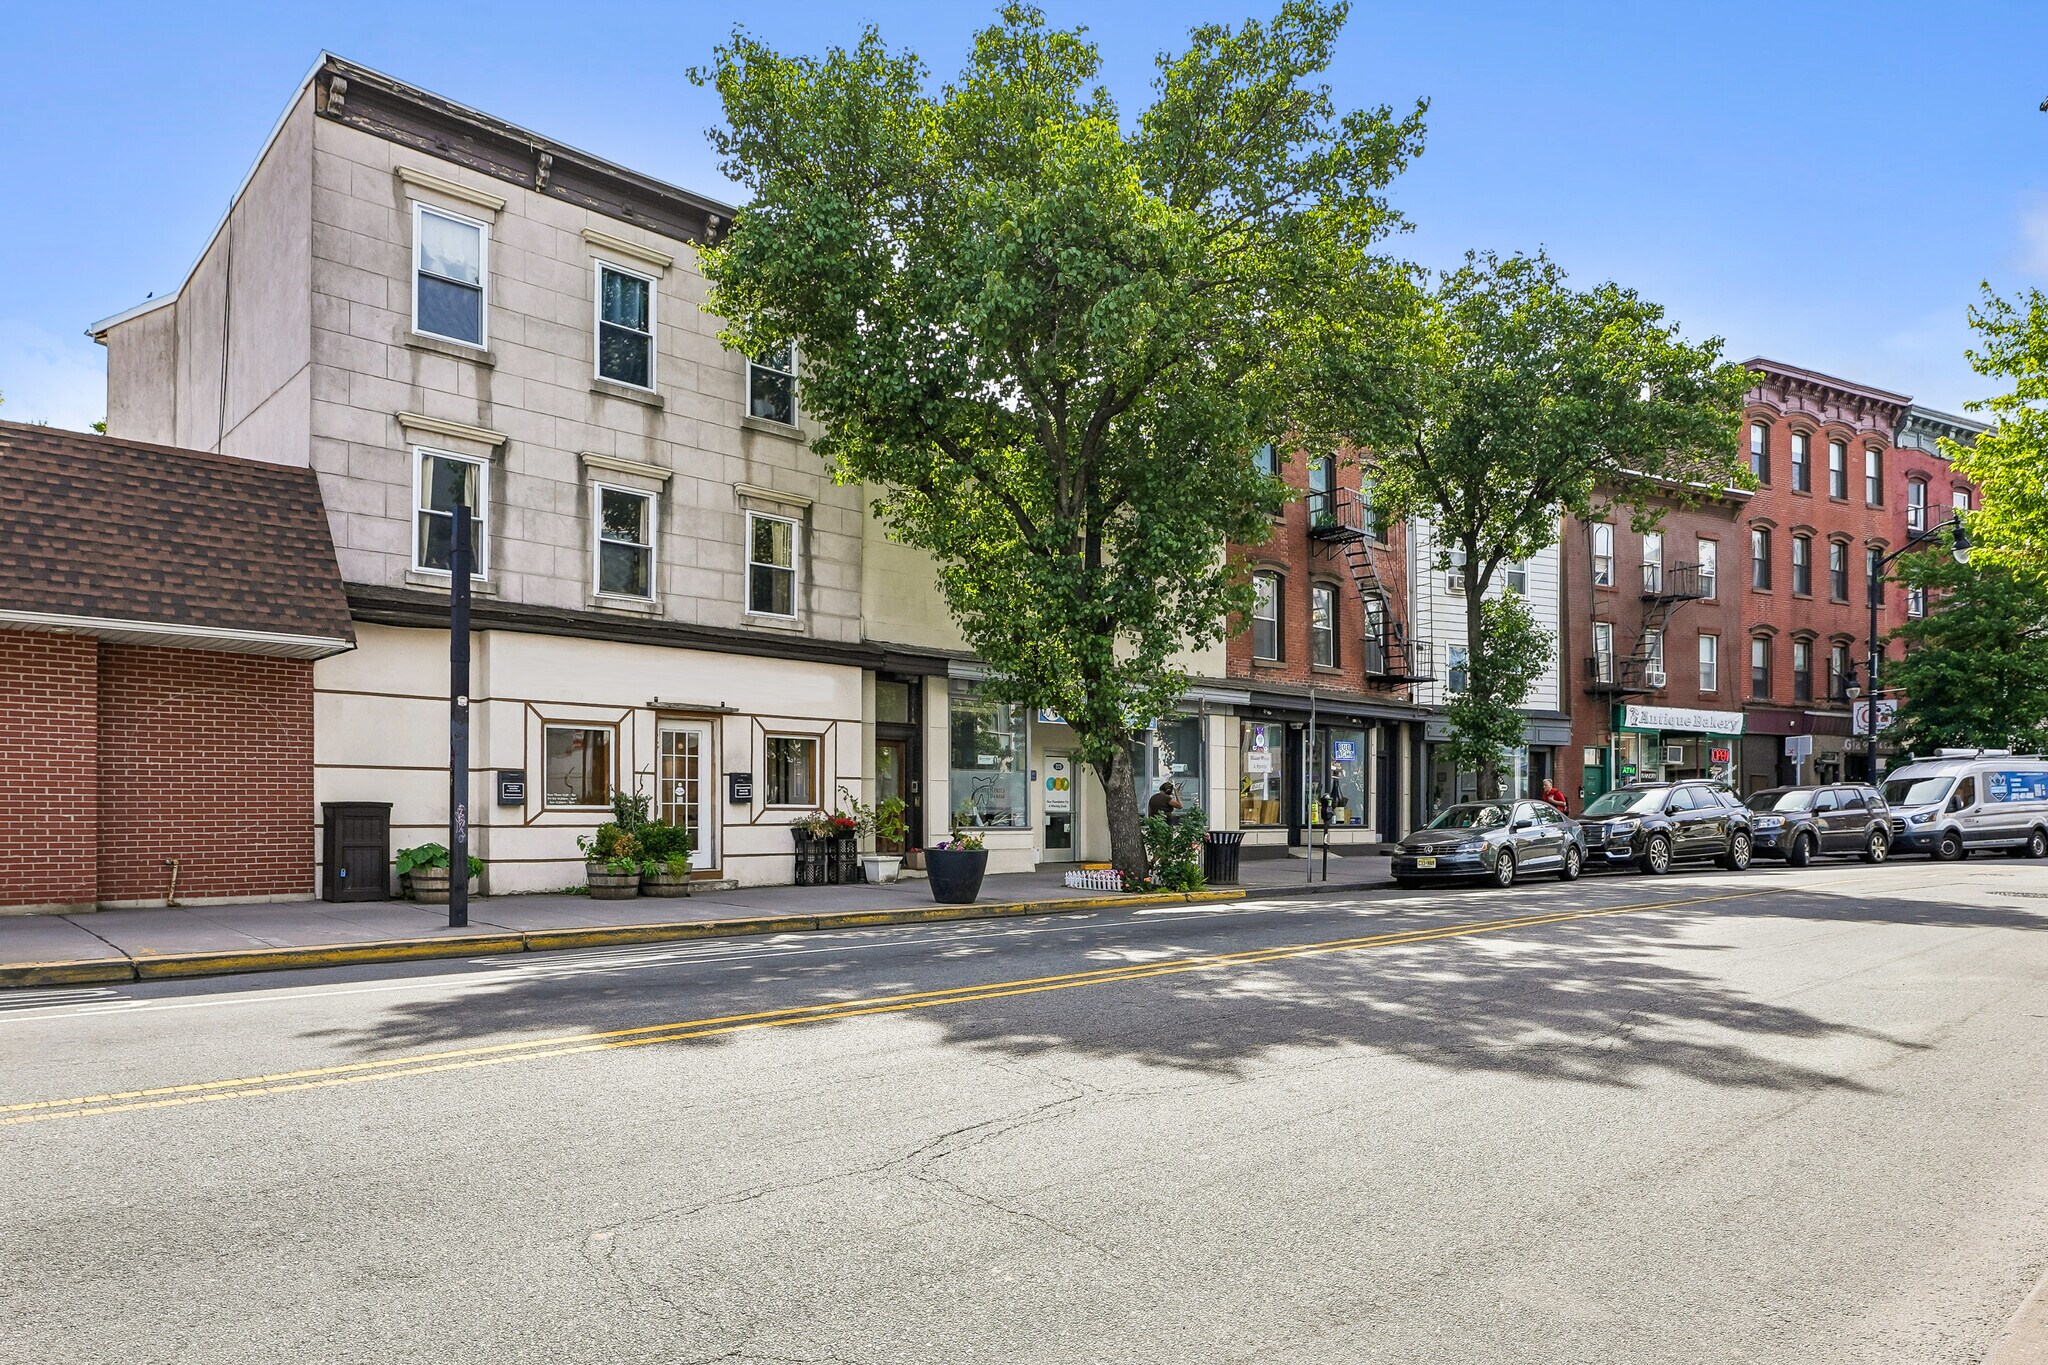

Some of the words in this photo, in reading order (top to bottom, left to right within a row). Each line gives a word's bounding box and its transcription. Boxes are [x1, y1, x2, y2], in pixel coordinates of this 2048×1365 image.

[1639, 711, 1691, 727] Antique
[1692, 715, 1738, 731] Bakery
[1712, 748, 1728, 761] OPEN
[1622, 766, 1636, 774] ATM
